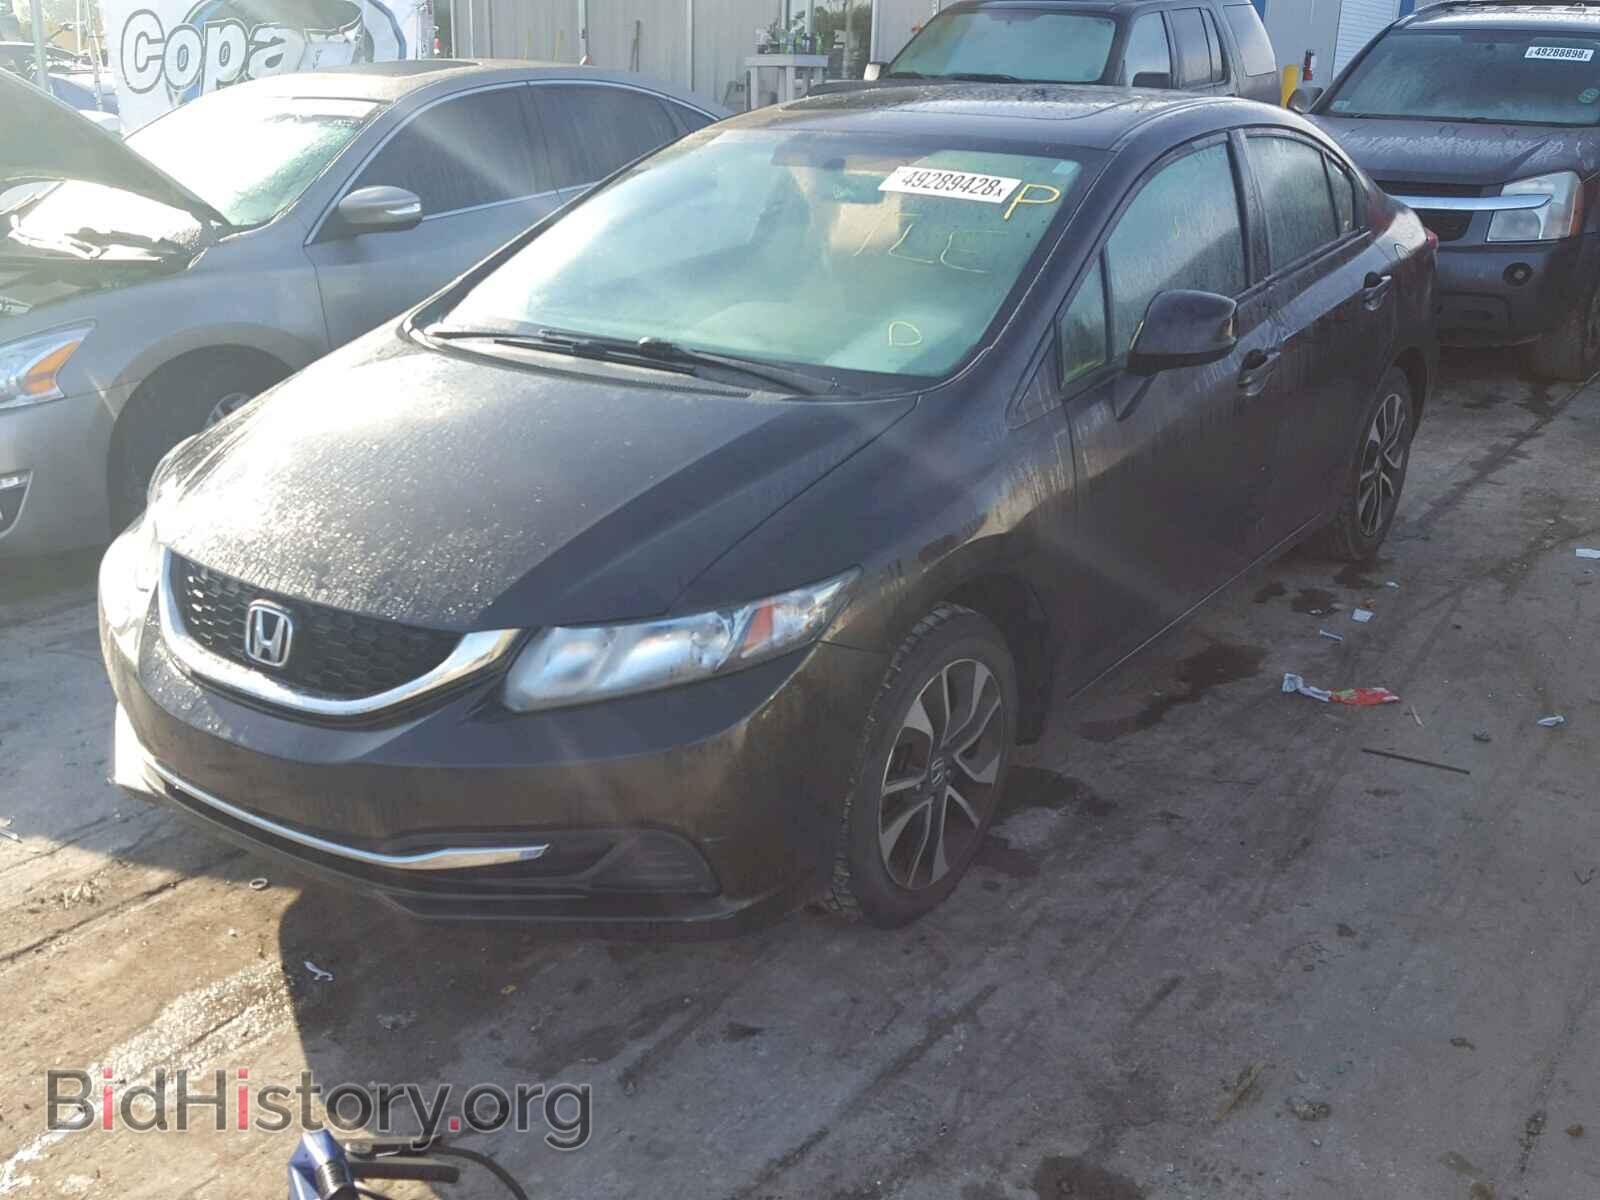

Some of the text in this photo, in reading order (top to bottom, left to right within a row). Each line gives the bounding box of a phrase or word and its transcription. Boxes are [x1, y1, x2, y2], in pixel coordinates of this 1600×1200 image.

[120, 8, 338, 96] Copa
[1003, 183, 1061, 220] P
[888, 320, 923, 346] D
